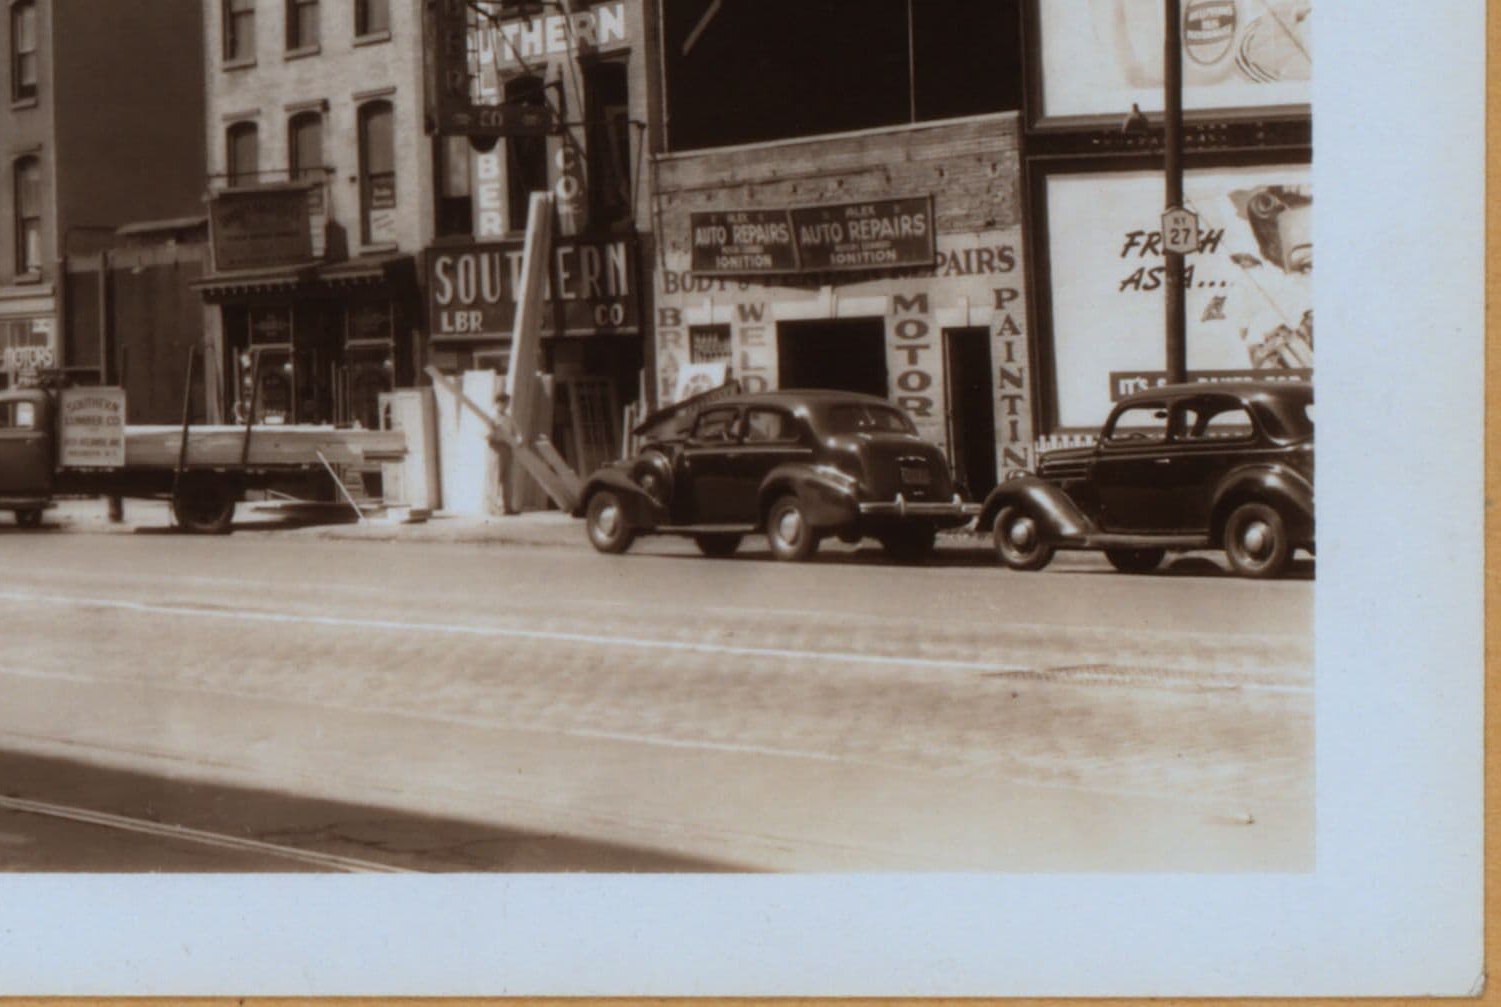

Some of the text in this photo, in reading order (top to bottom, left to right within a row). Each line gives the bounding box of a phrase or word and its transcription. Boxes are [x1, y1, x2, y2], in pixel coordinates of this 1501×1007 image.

[467, 4, 625, 65] UTHERN
[695, 223, 790, 245] AUTO REPAIRS
[801, 214, 927, 244] AUTO REPAIRS
[1120, 228, 1224, 258] FRH
[1170, 228, 1191, 245] 27
[436, 242, 628, 305] SOUTERN
[1119, 266, 1165, 292] AS
[441, 310, 483, 333] LBR
[892, 293, 933, 417] MOTOR
[1119, 376, 1149, 396] IT'S
